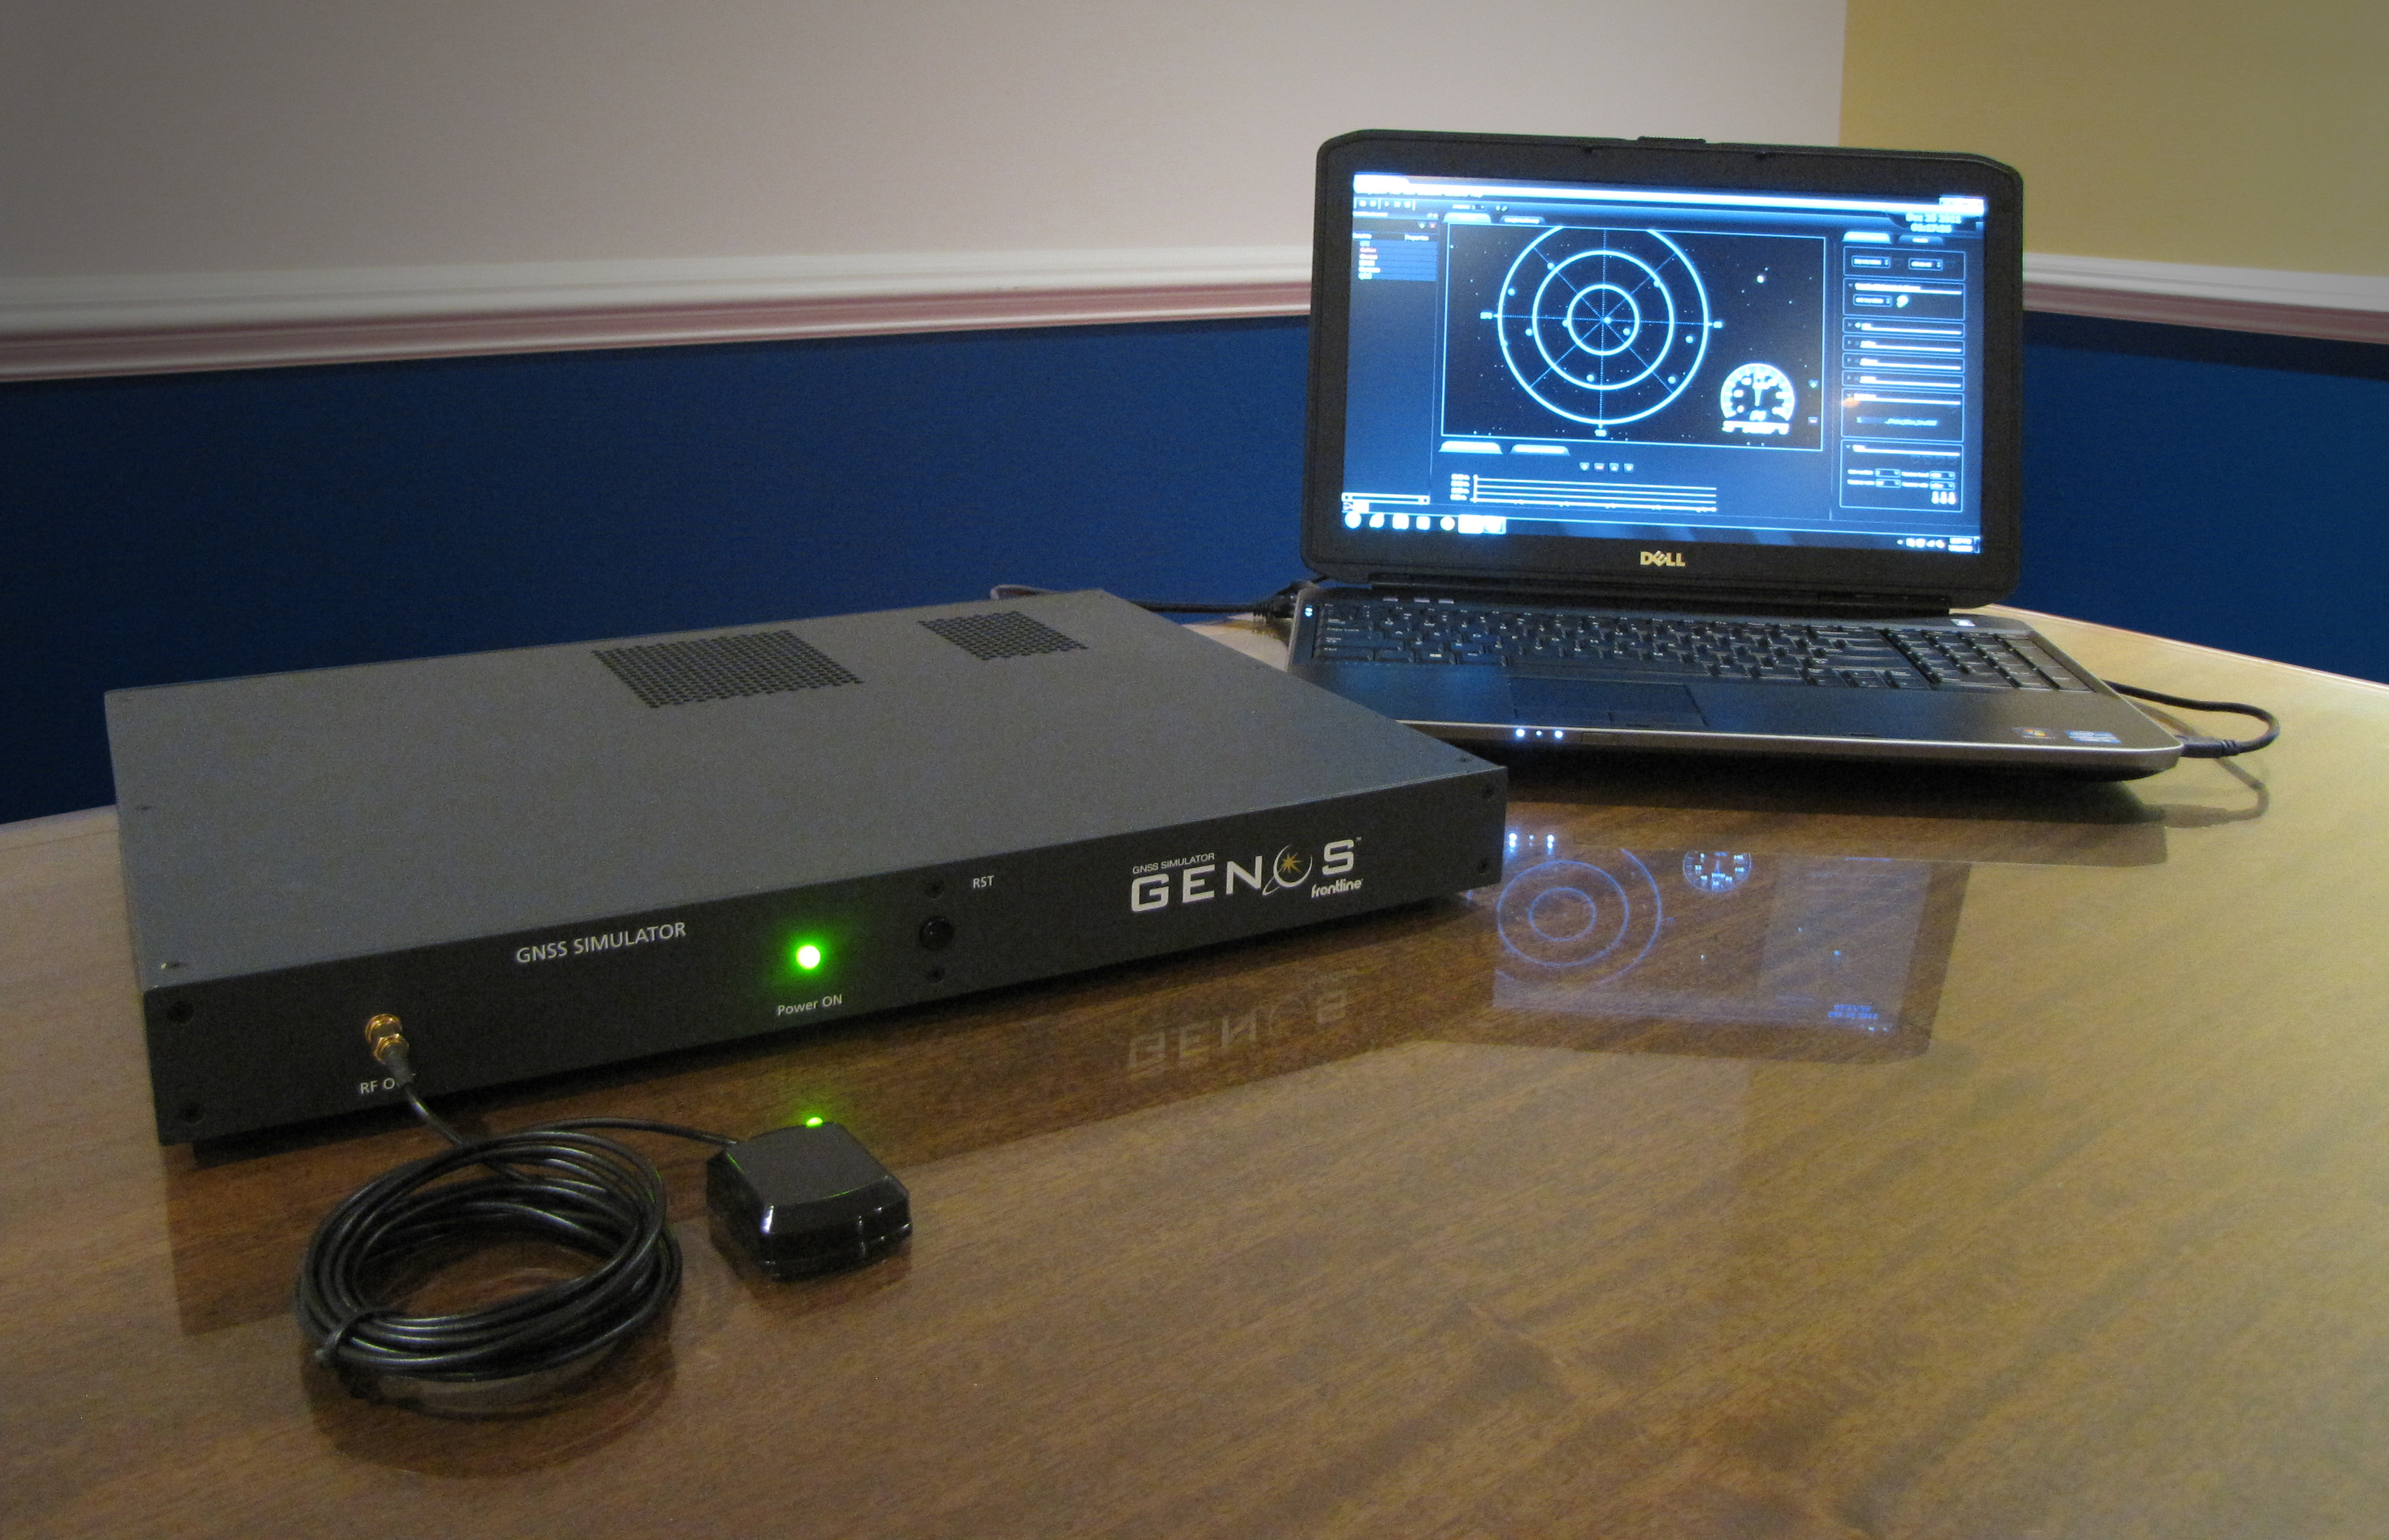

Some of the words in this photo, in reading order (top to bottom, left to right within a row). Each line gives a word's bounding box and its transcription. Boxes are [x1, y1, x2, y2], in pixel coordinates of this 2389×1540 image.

[1640, 550, 1686, 566] DELL
[1132, 862, 1160, 874] GNSS
[1160, 852, 1215, 869] SIMULATOR
[972, 875, 995, 889] RST
[1310, 879, 1362, 898] frontline
[516, 941, 568, 963] GNSS
[574, 922, 687, 955] SIMULATOR
[777, 1000, 819, 1017] Power
[822, 994, 843, 1008] ON
[360, 1080, 378, 1095] RF
